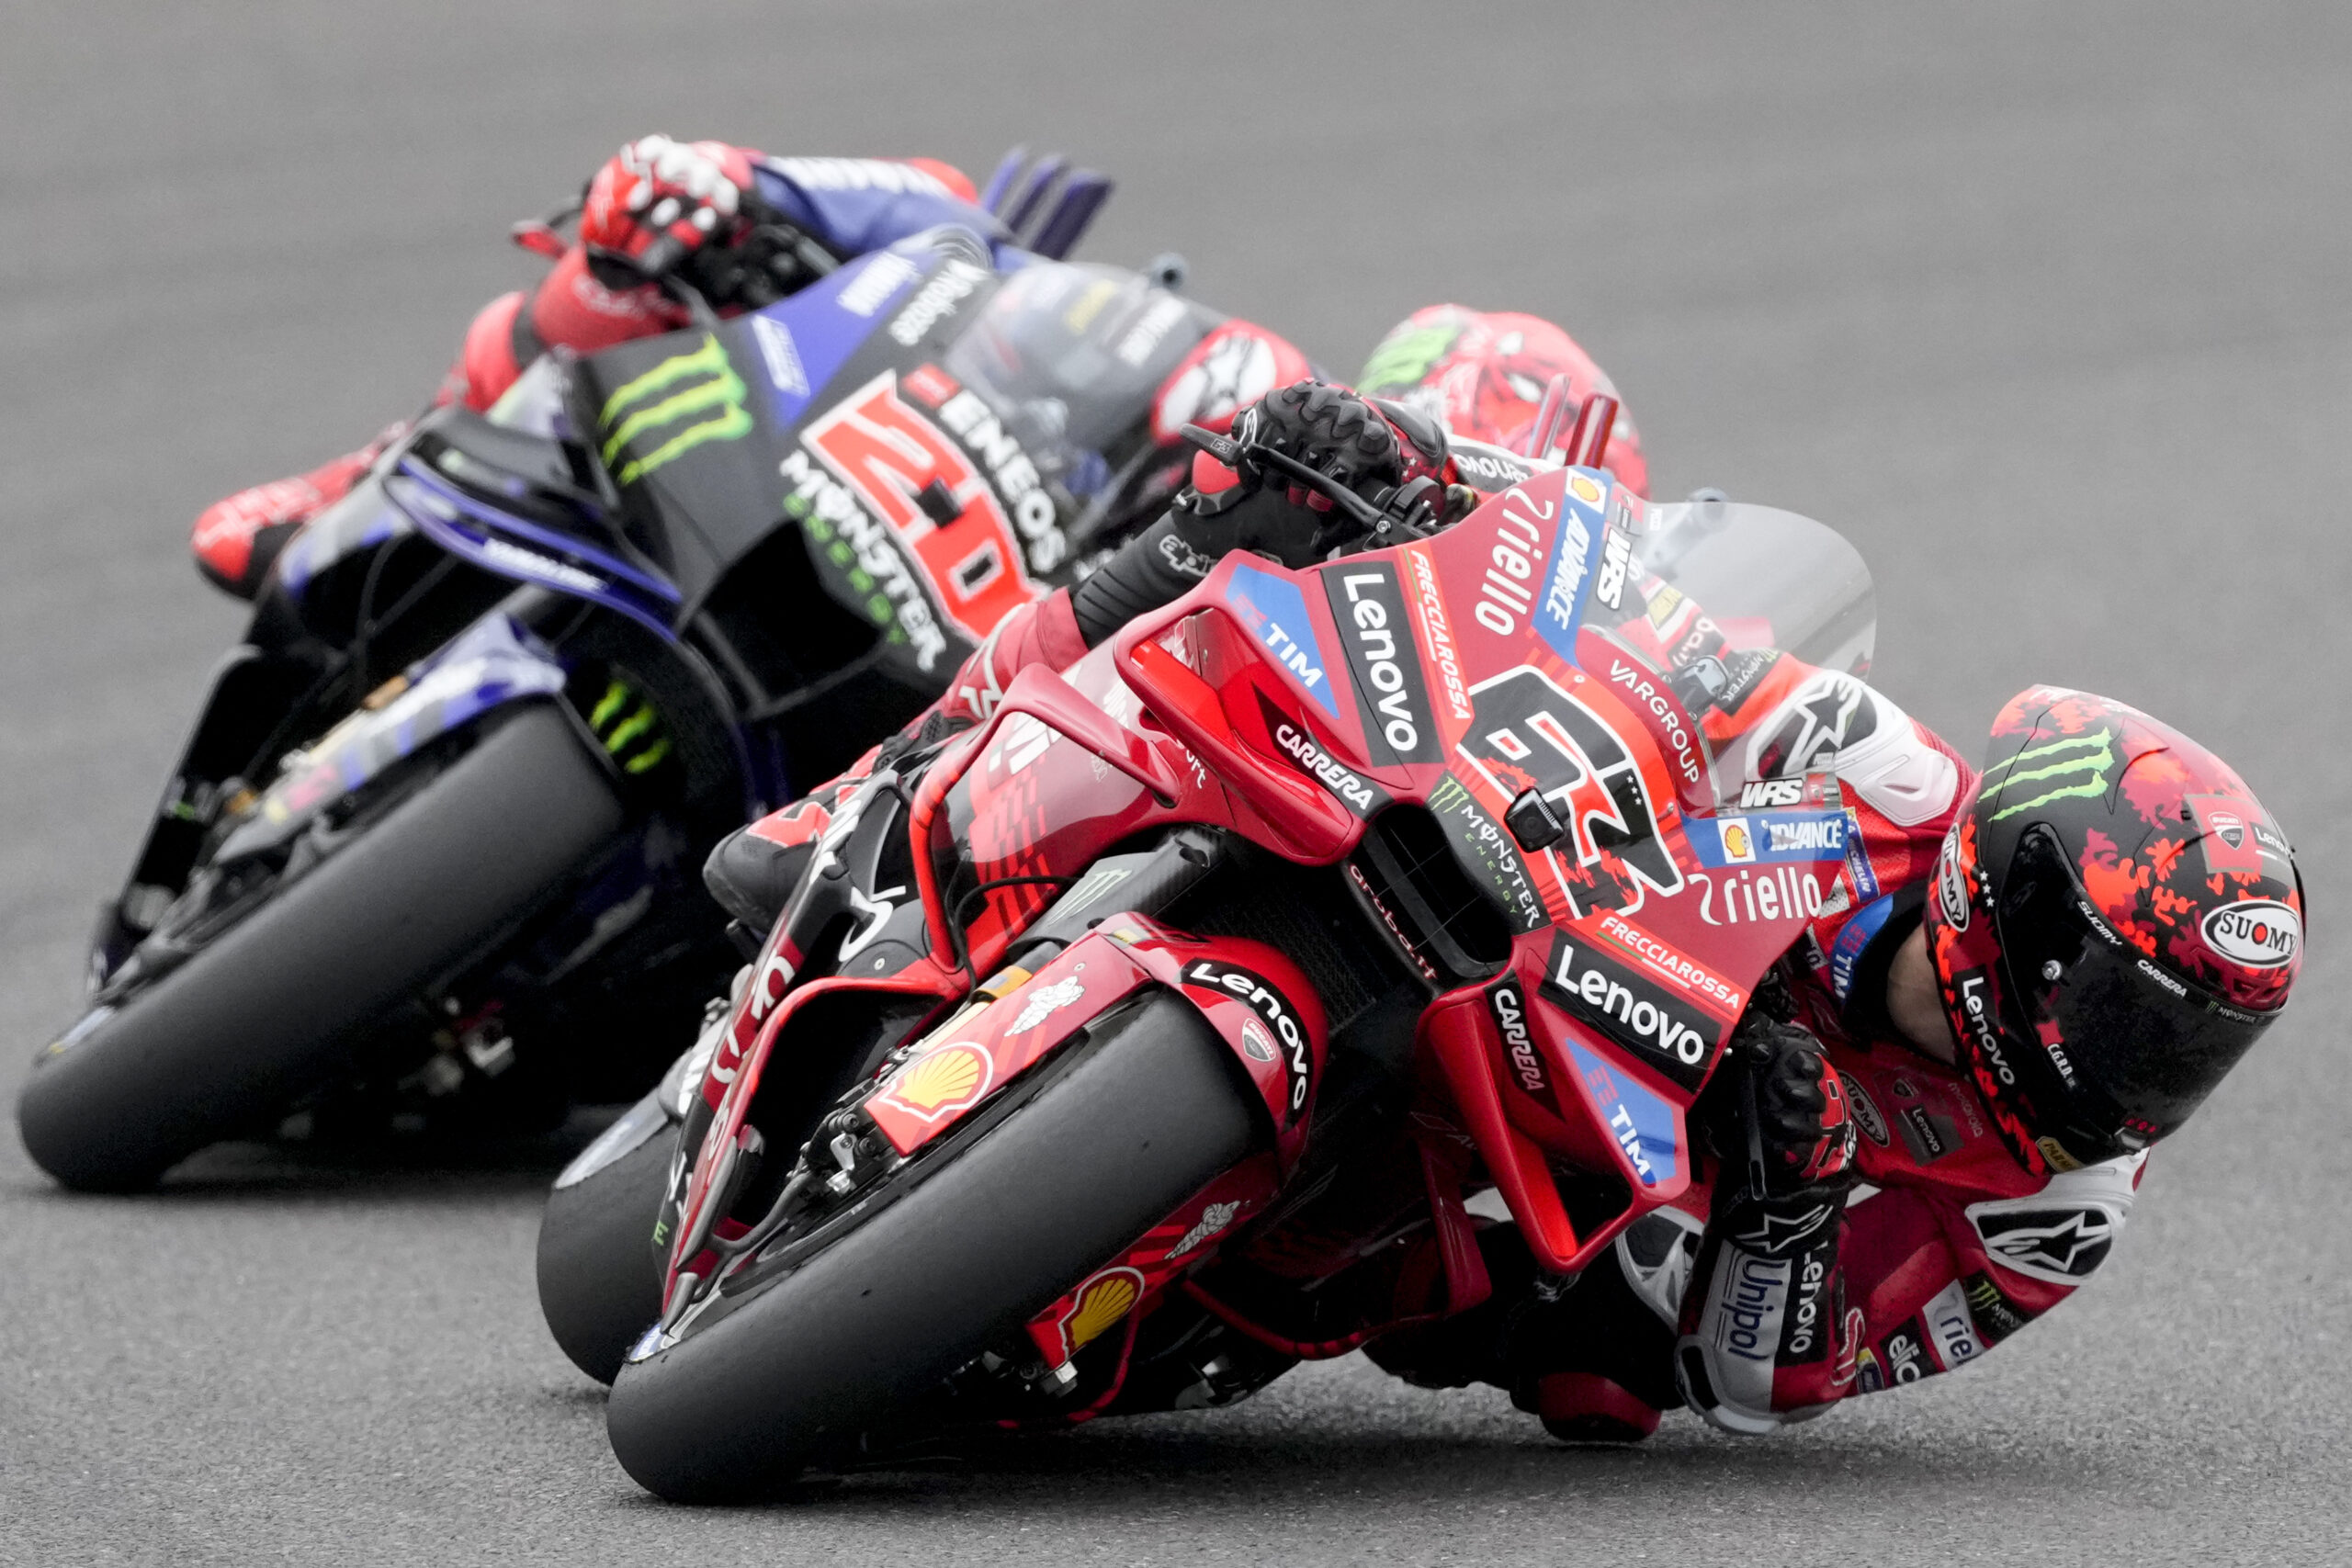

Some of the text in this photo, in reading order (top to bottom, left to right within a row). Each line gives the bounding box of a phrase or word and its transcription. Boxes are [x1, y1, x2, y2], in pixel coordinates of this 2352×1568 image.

[939, 390, 1066, 572] ENEOS
[1453, 453, 1530, 483] enovo
[779, 449, 946, 672] MONSTER
[1475, 508, 1543, 636] riello
[1545, 507, 1590, 630] ADVANCE
[1597, 527, 1633, 611] WRS
[1259, 623, 1323, 689] TIM
[1343, 573, 1419, 751] Lenovo
[1410, 549, 1472, 720] FRECCIAROSSA
[1610, 659, 1700, 783] VARGROUP
[1276, 724, 1374, 813] CARRERA
[1739, 780, 1804, 808] WRS
[1462, 804, 1541, 928] MONSTER
[1464, 831, 1518, 914] ENERGY
[1768, 820, 1842, 852] DVANCE
[1724, 866, 1823, 923] riello
[2077, 901, 2121, 946] SUOMY
[2220, 910, 2298, 956] SUOMY
[1555, 944, 1704, 1065] Lenovo
[1600, 916, 1740, 1010] FRECCIAROSSA
[1833, 953, 1853, 998] TIM
[2137, 959, 2188, 998] CARRERA
[1190, 963, 1307, 1110] Lenovo
[1494, 987, 1545, 1090] CARRERA
[1962, 976, 2015, 1086] Lenovo
[1611, 1103, 1651, 1177] TIM
[1912, 1108, 1940, 1152] Lenovo
[1721, 1256, 1789, 1361] Unipol
